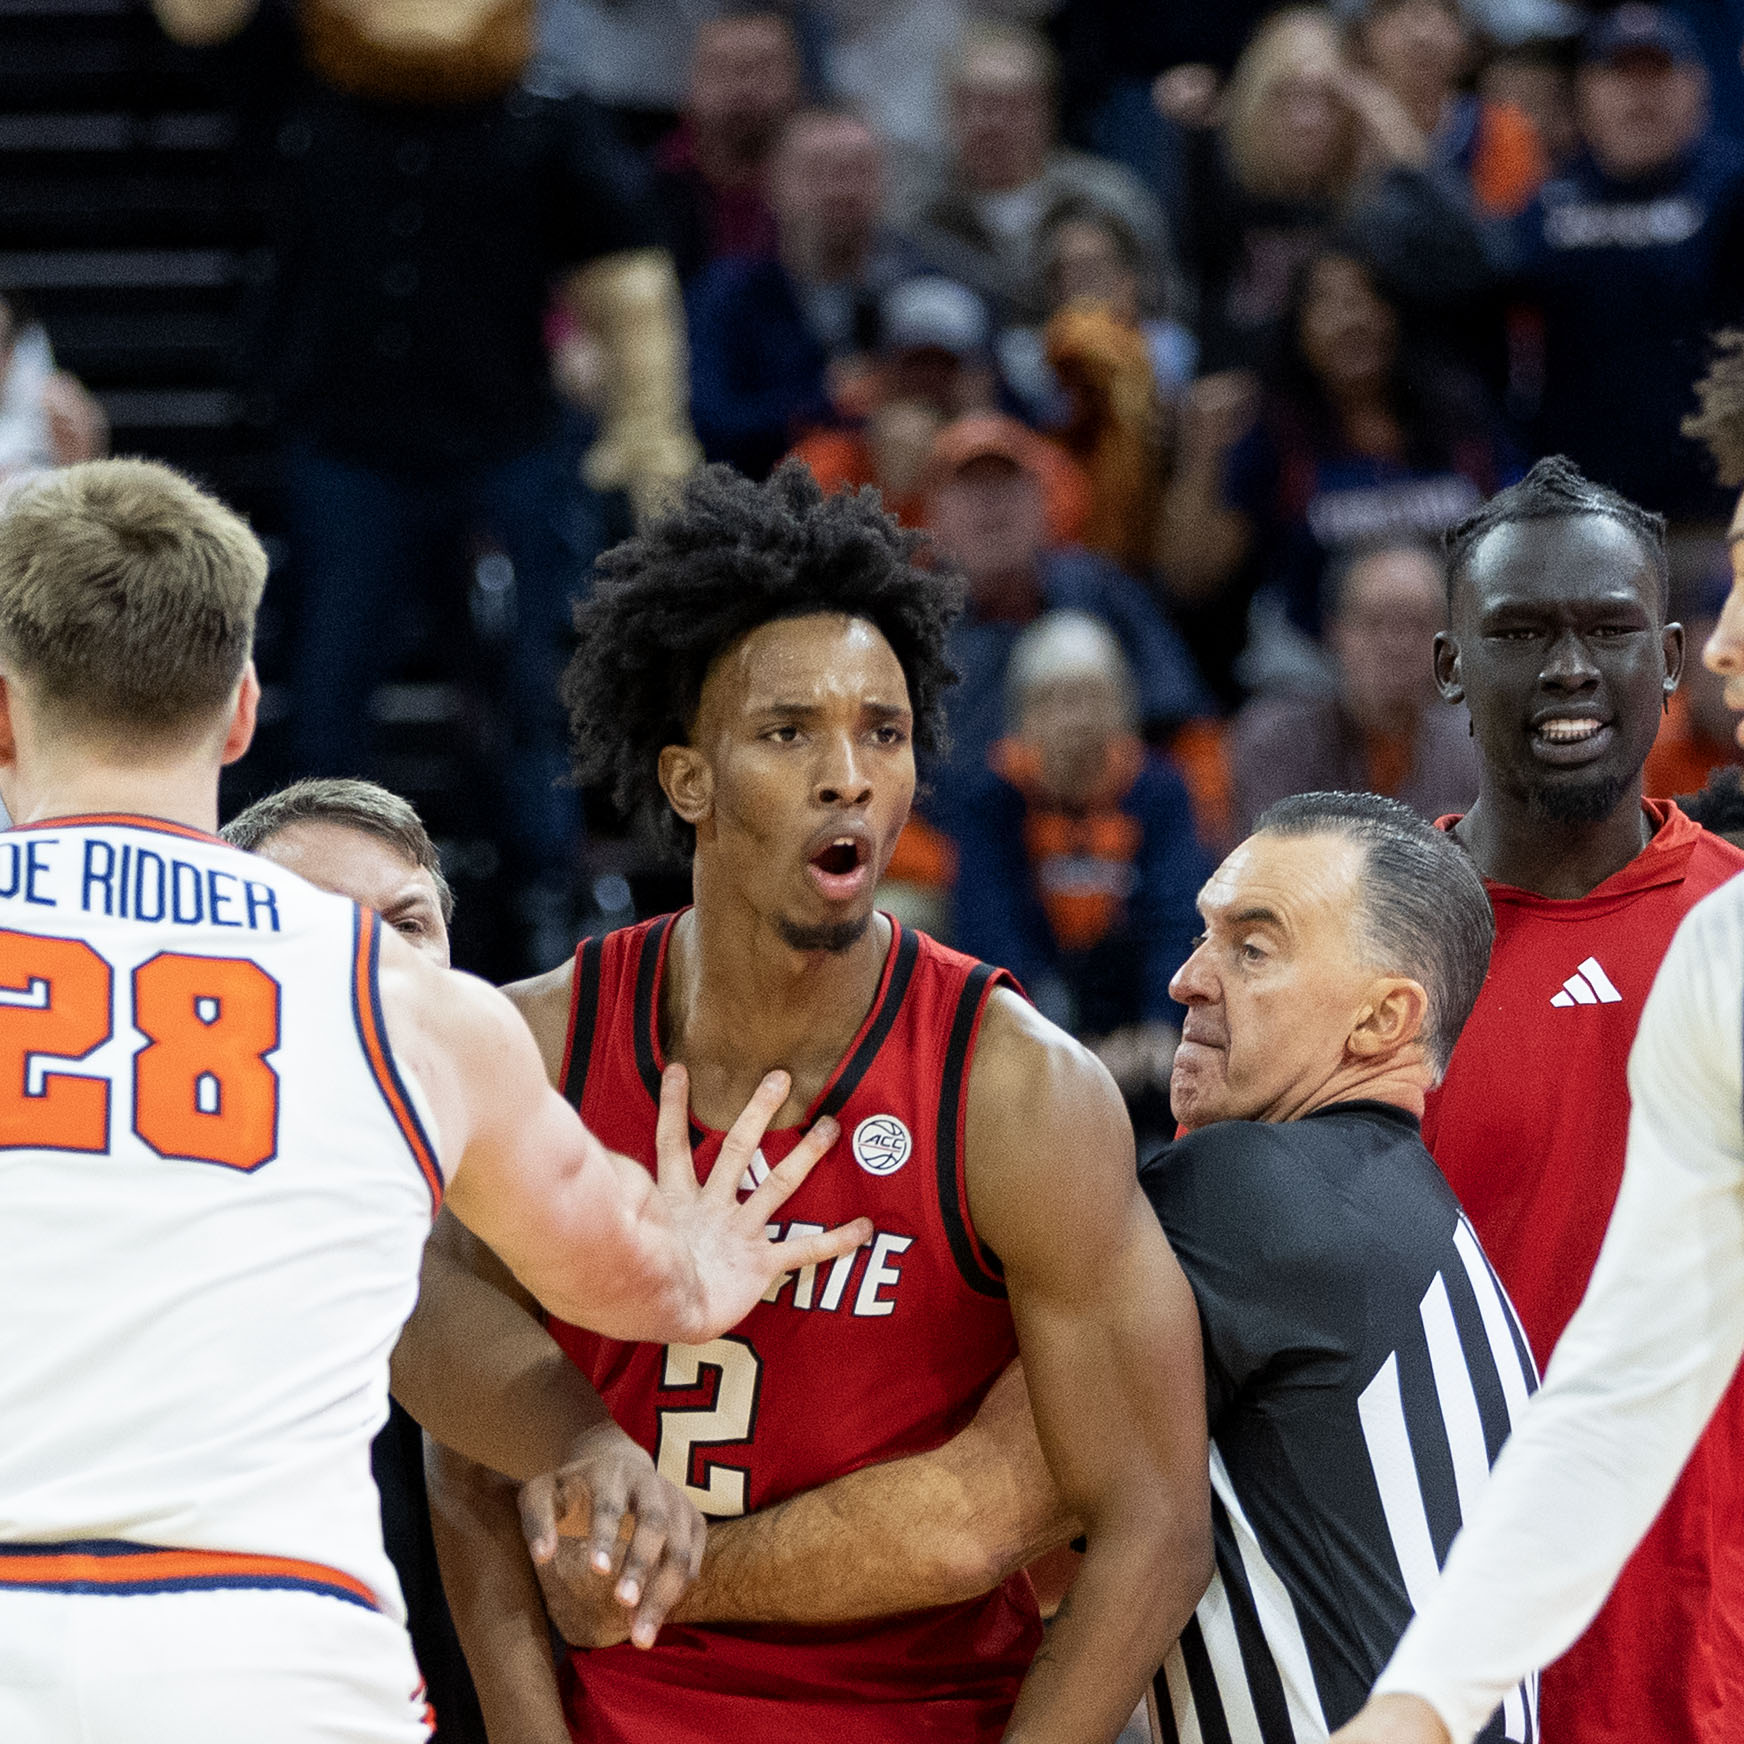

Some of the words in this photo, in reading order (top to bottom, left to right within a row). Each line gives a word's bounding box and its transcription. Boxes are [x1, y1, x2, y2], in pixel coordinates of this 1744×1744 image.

[81, 840, 283, 934] RIDDER
[864, 1134, 905, 1150] ACC
[762, 1220, 916, 1317] ATE
[655, 1334, 764, 1518] 2
